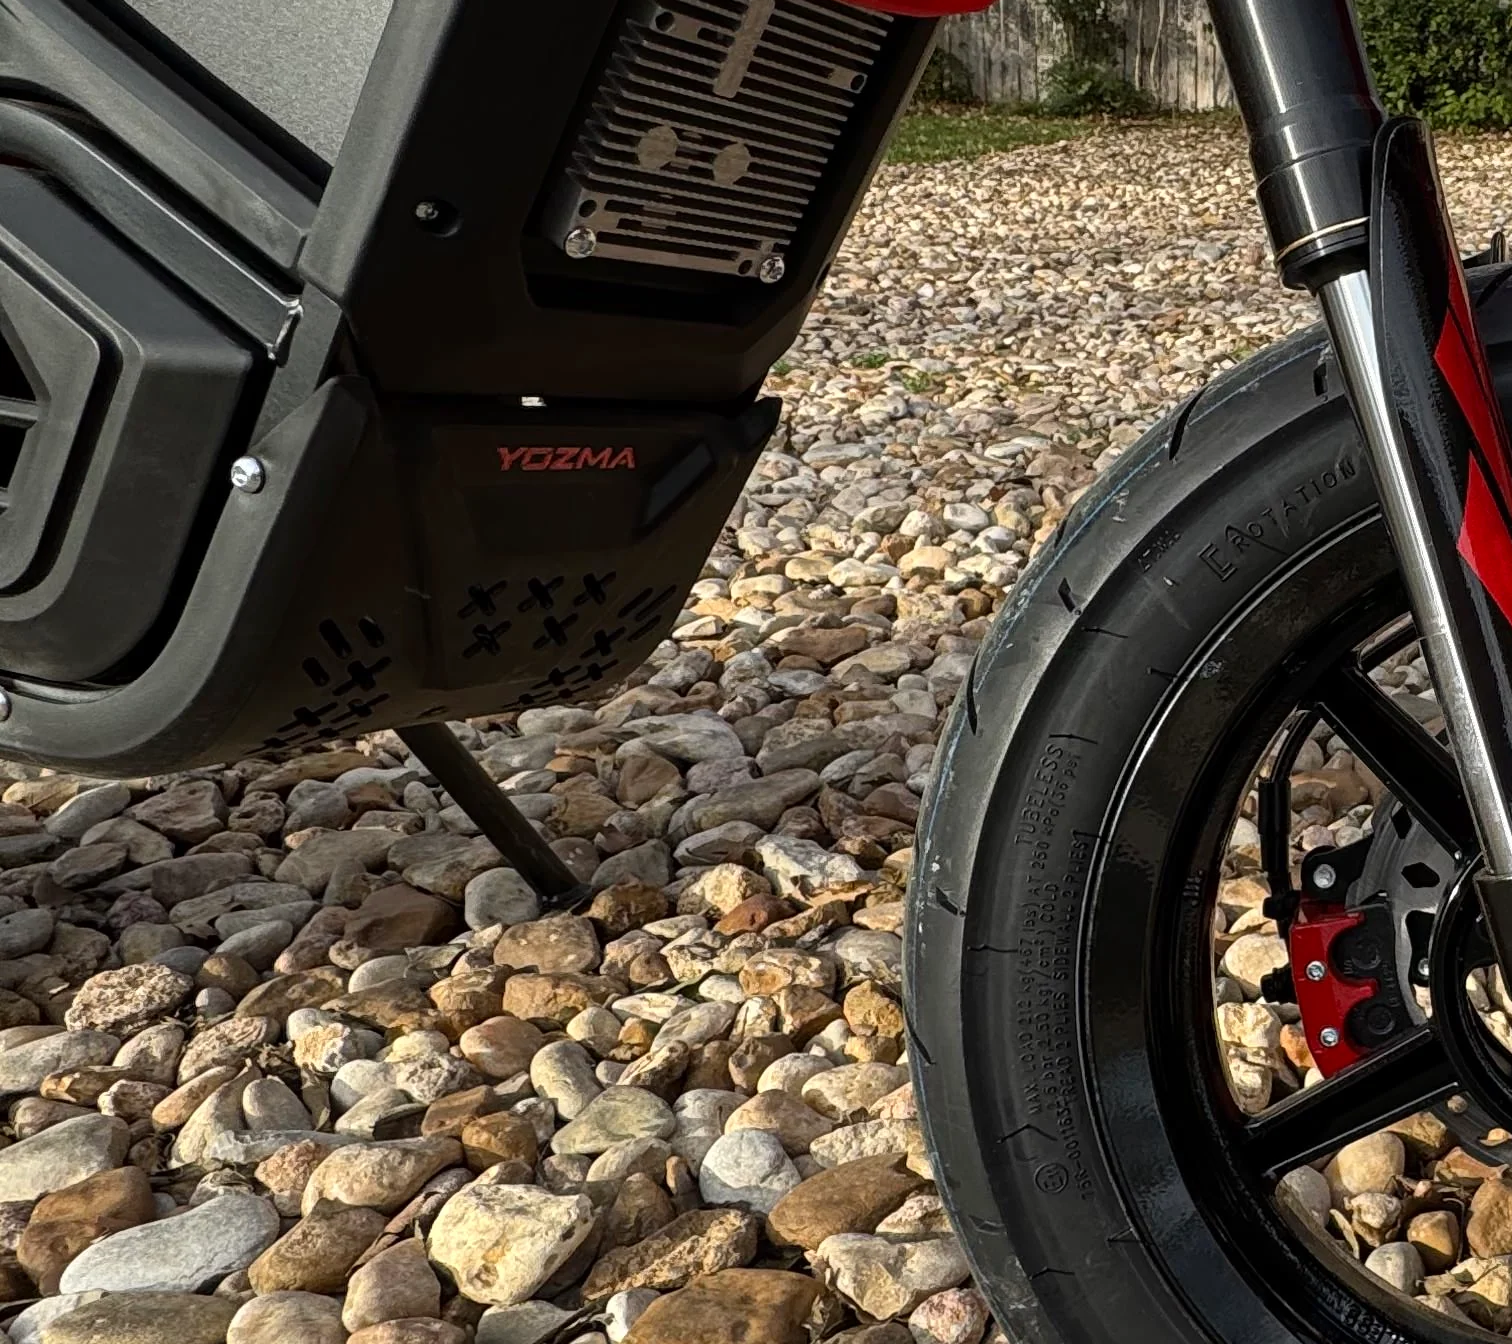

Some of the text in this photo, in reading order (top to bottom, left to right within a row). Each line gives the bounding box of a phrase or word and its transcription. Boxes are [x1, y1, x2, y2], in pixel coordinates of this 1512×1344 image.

[496, 446, 637, 472] YOZMA
[1229, 456, 1357, 554] ROTATION
[1014, 742, 1063, 845] TUBELESS
[1030, 840, 1050, 869] 250
[1063, 838, 1088, 883] PLIES
[1025, 874, 1042, 897] AT
[1039, 881, 1058, 922] COLD
[1054, 903, 1075, 979] SIDEWALL
[1051, 992, 1071, 1035] PLIES
[1018, 1031, 1036, 1072] LOAD
[1055, 1055, 1080, 1108] TREAD
